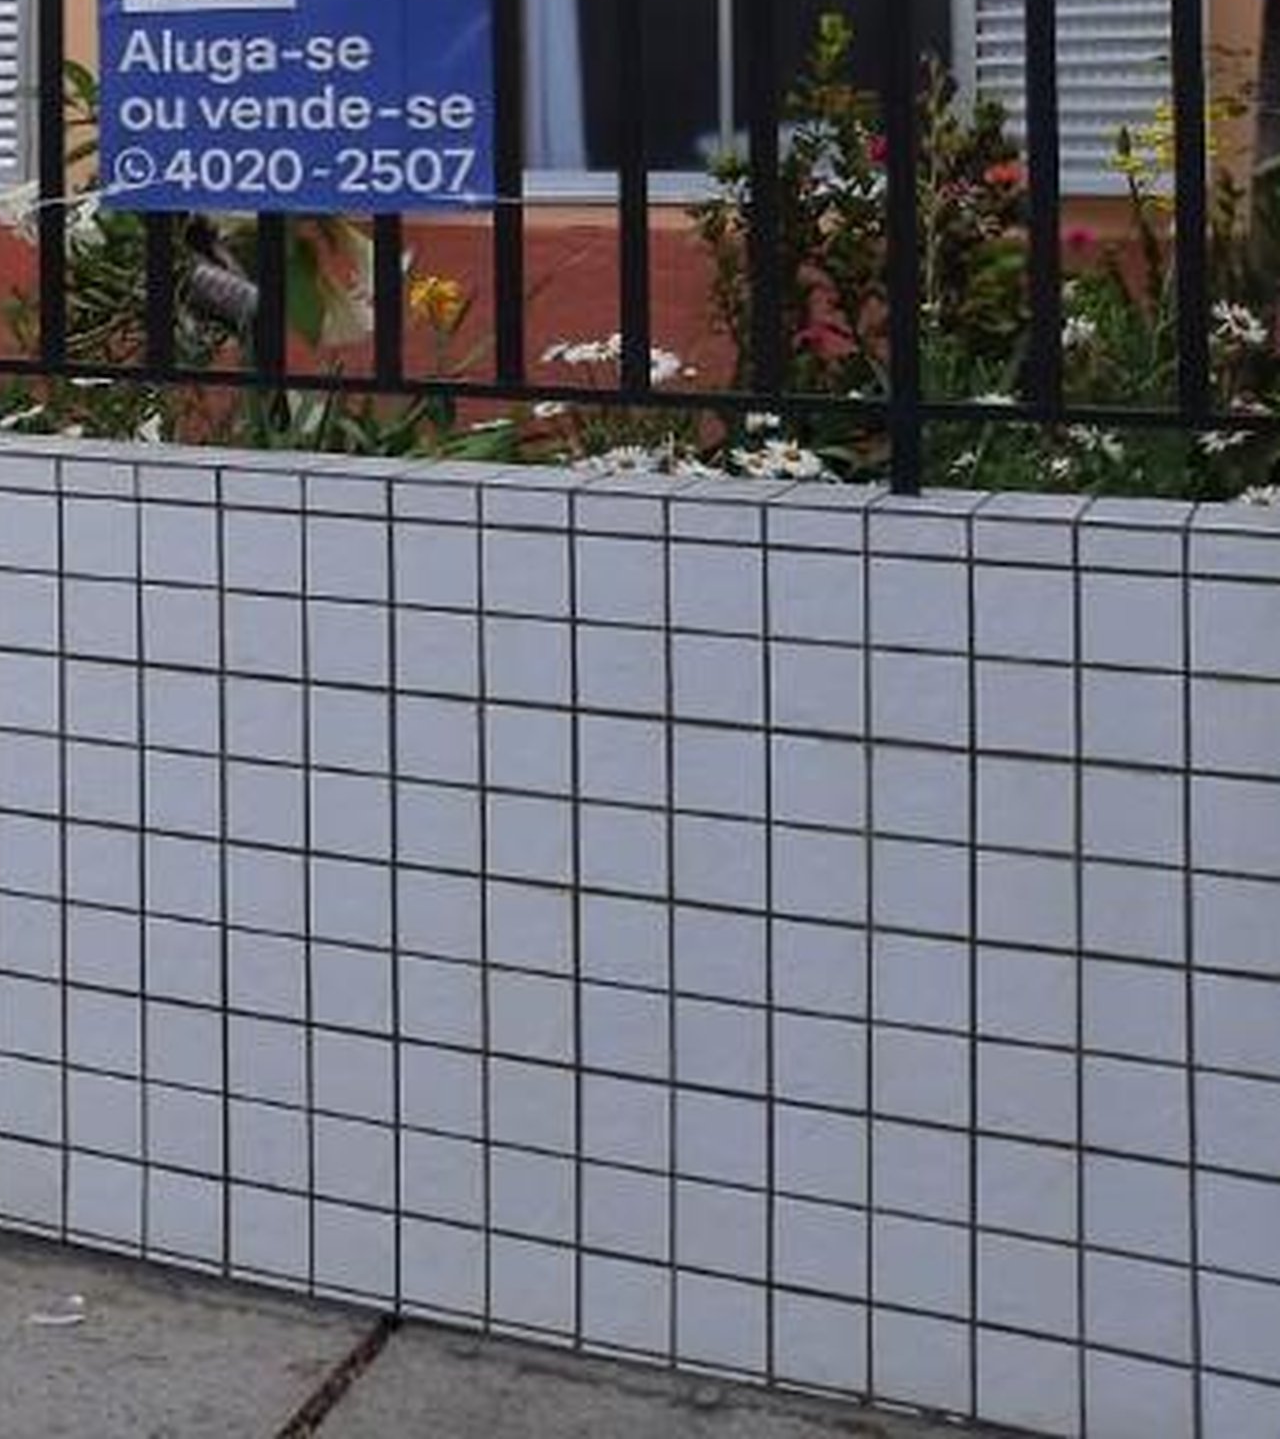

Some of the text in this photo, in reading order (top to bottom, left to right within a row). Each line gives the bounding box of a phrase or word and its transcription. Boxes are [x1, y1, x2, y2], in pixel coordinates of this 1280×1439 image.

[119, 30, 372, 84] Aluga-se
[120, 85, 474, 131] ou vende-se
